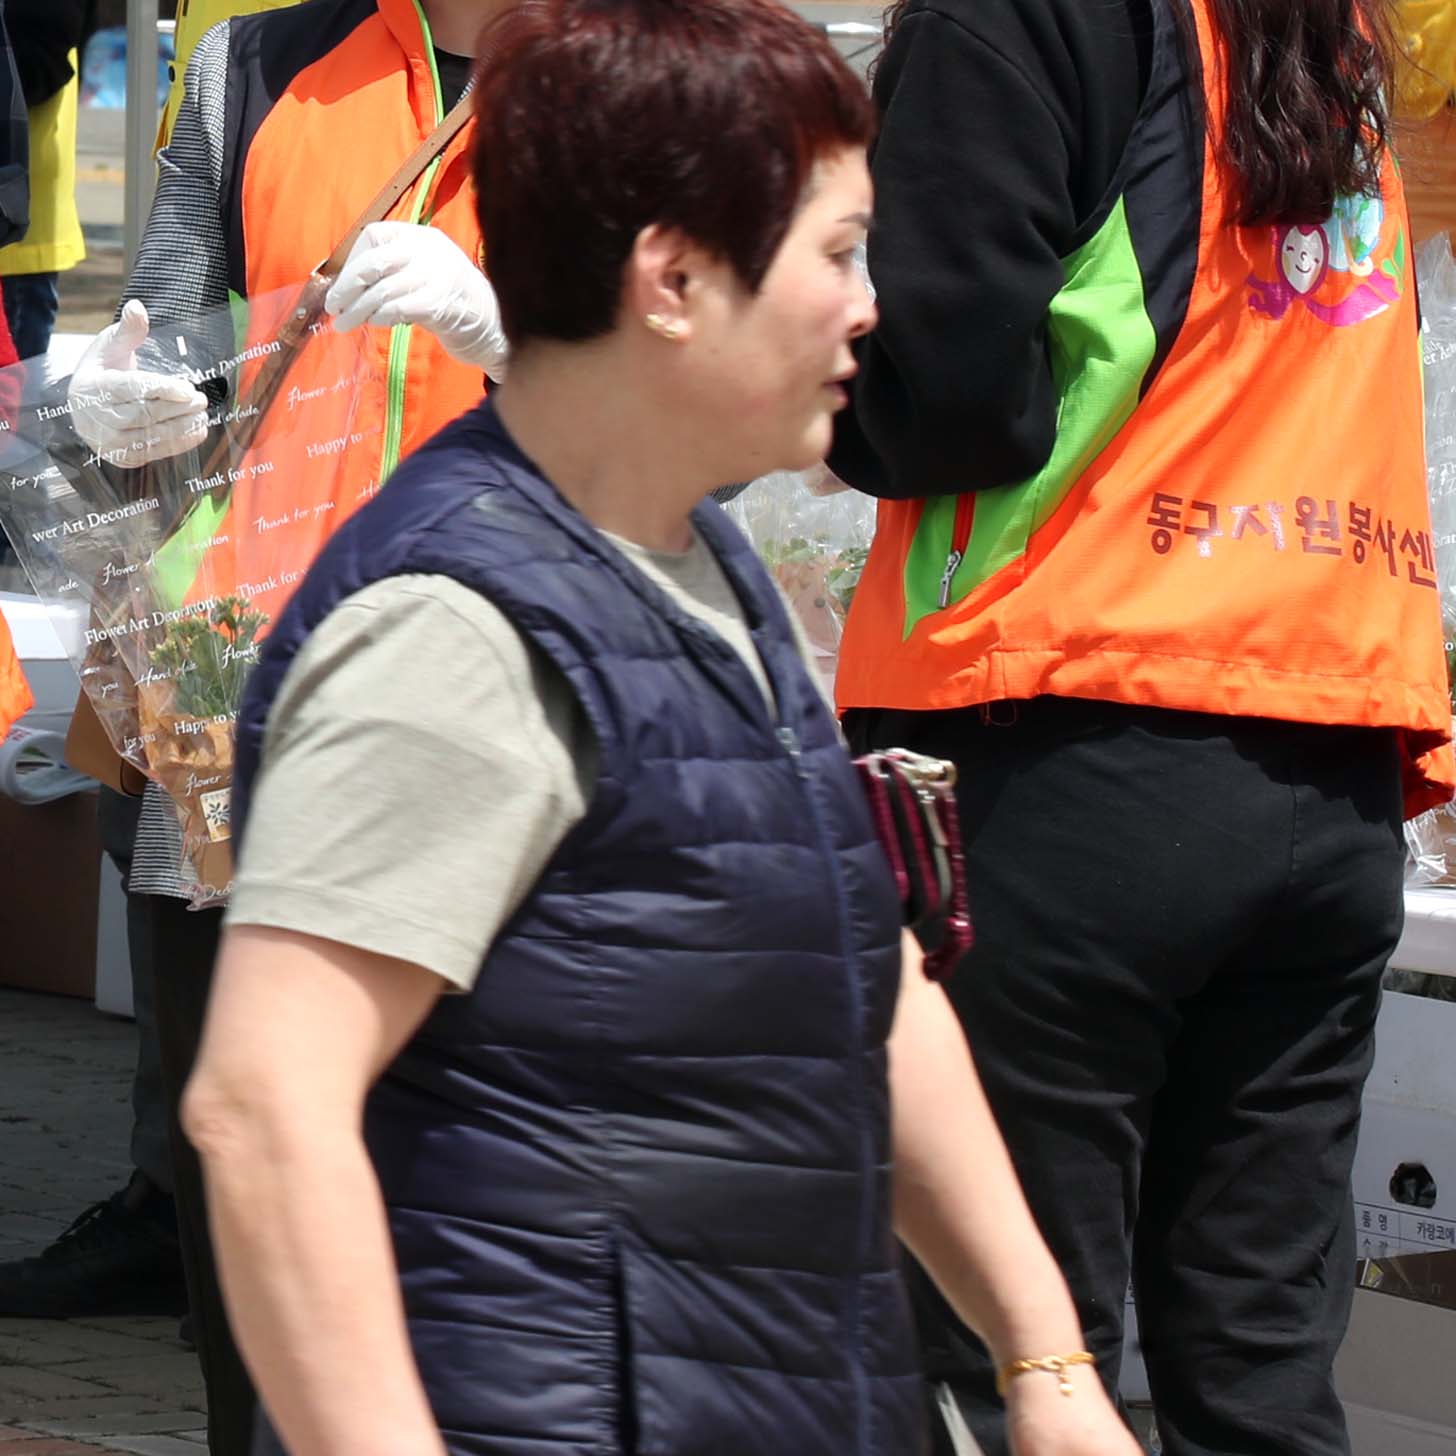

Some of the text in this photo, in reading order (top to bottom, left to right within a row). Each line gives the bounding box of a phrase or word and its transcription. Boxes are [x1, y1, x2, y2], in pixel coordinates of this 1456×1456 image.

[36, 391, 112, 422] Hand Made
[306, 435, 348, 459] Happy
[185, 460, 274, 493] Thank for you
[62, 520, 85, 537] Art
[87, 496, 160, 529] Decoration
[253, 515, 289, 534] Thank
[313, 500, 335, 517] you
[102, 562, 138, 586] Flower
[236, 569, 298, 598] Thank for
[84, 624, 127, 645] Flower
[129, 615, 150, 632] Art
